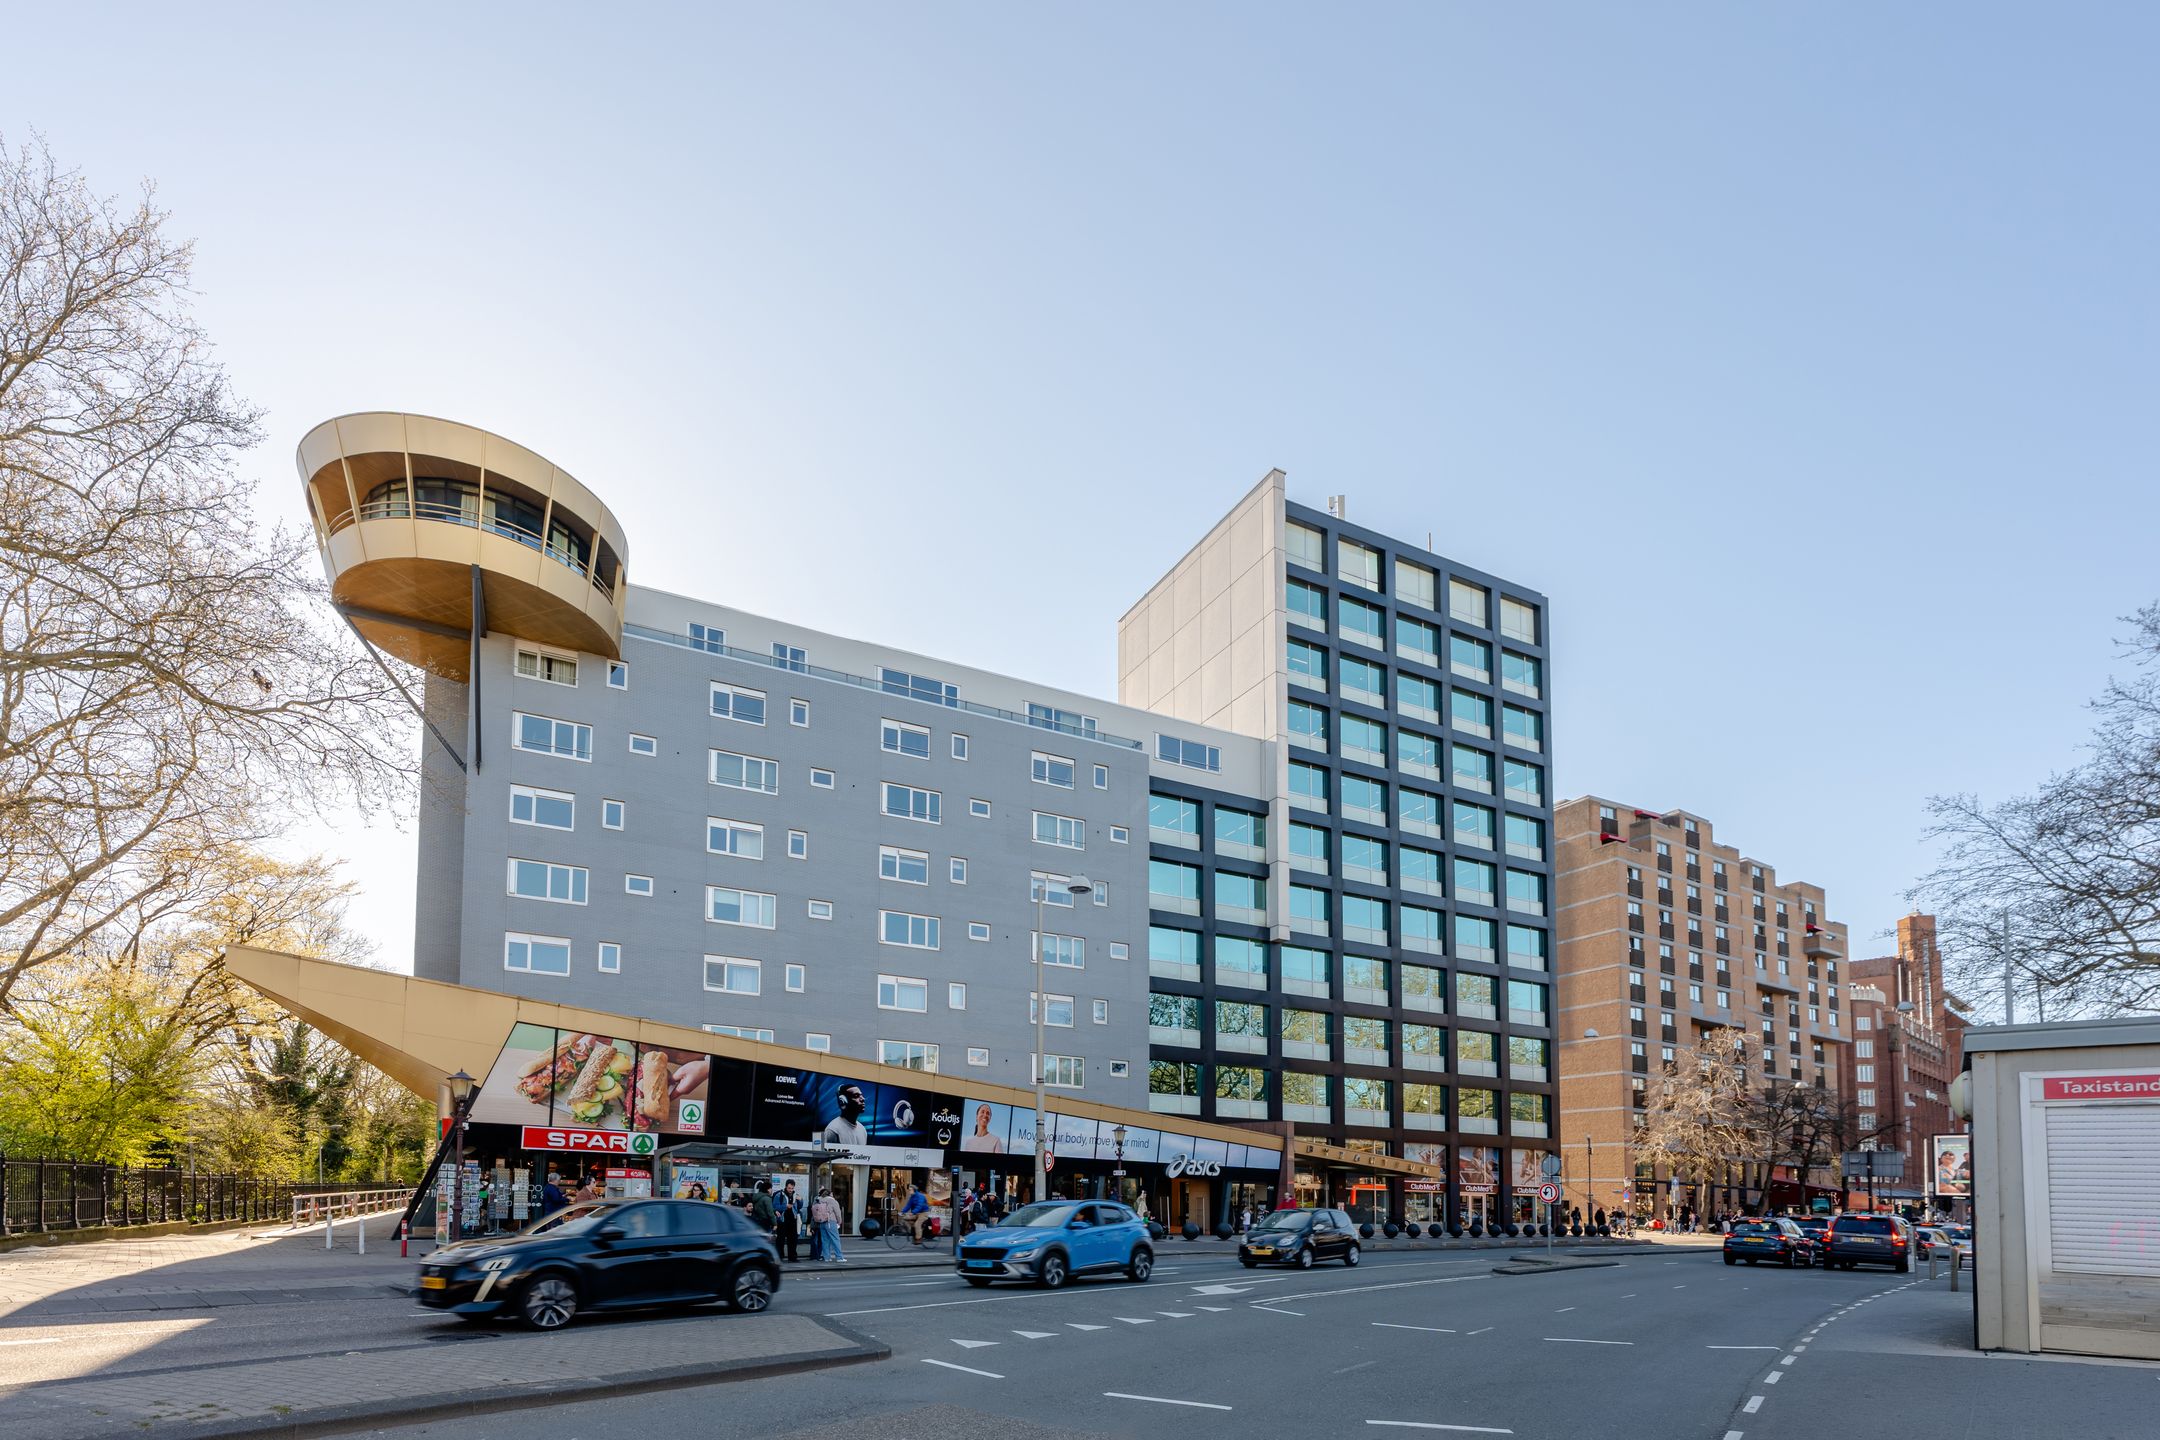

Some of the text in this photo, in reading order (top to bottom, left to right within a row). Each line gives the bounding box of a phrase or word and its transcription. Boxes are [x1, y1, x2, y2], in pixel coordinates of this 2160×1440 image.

[931, 1112, 960, 1126] Koudijs
[547, 1132, 628, 1150] SPAR
[1018, 1128, 1037, 1141] Mov
[1111, 1138, 1130, 1149] yur
[1131, 1138, 1150, 1149] mind
[853, 1154, 871, 1162] Gallery
